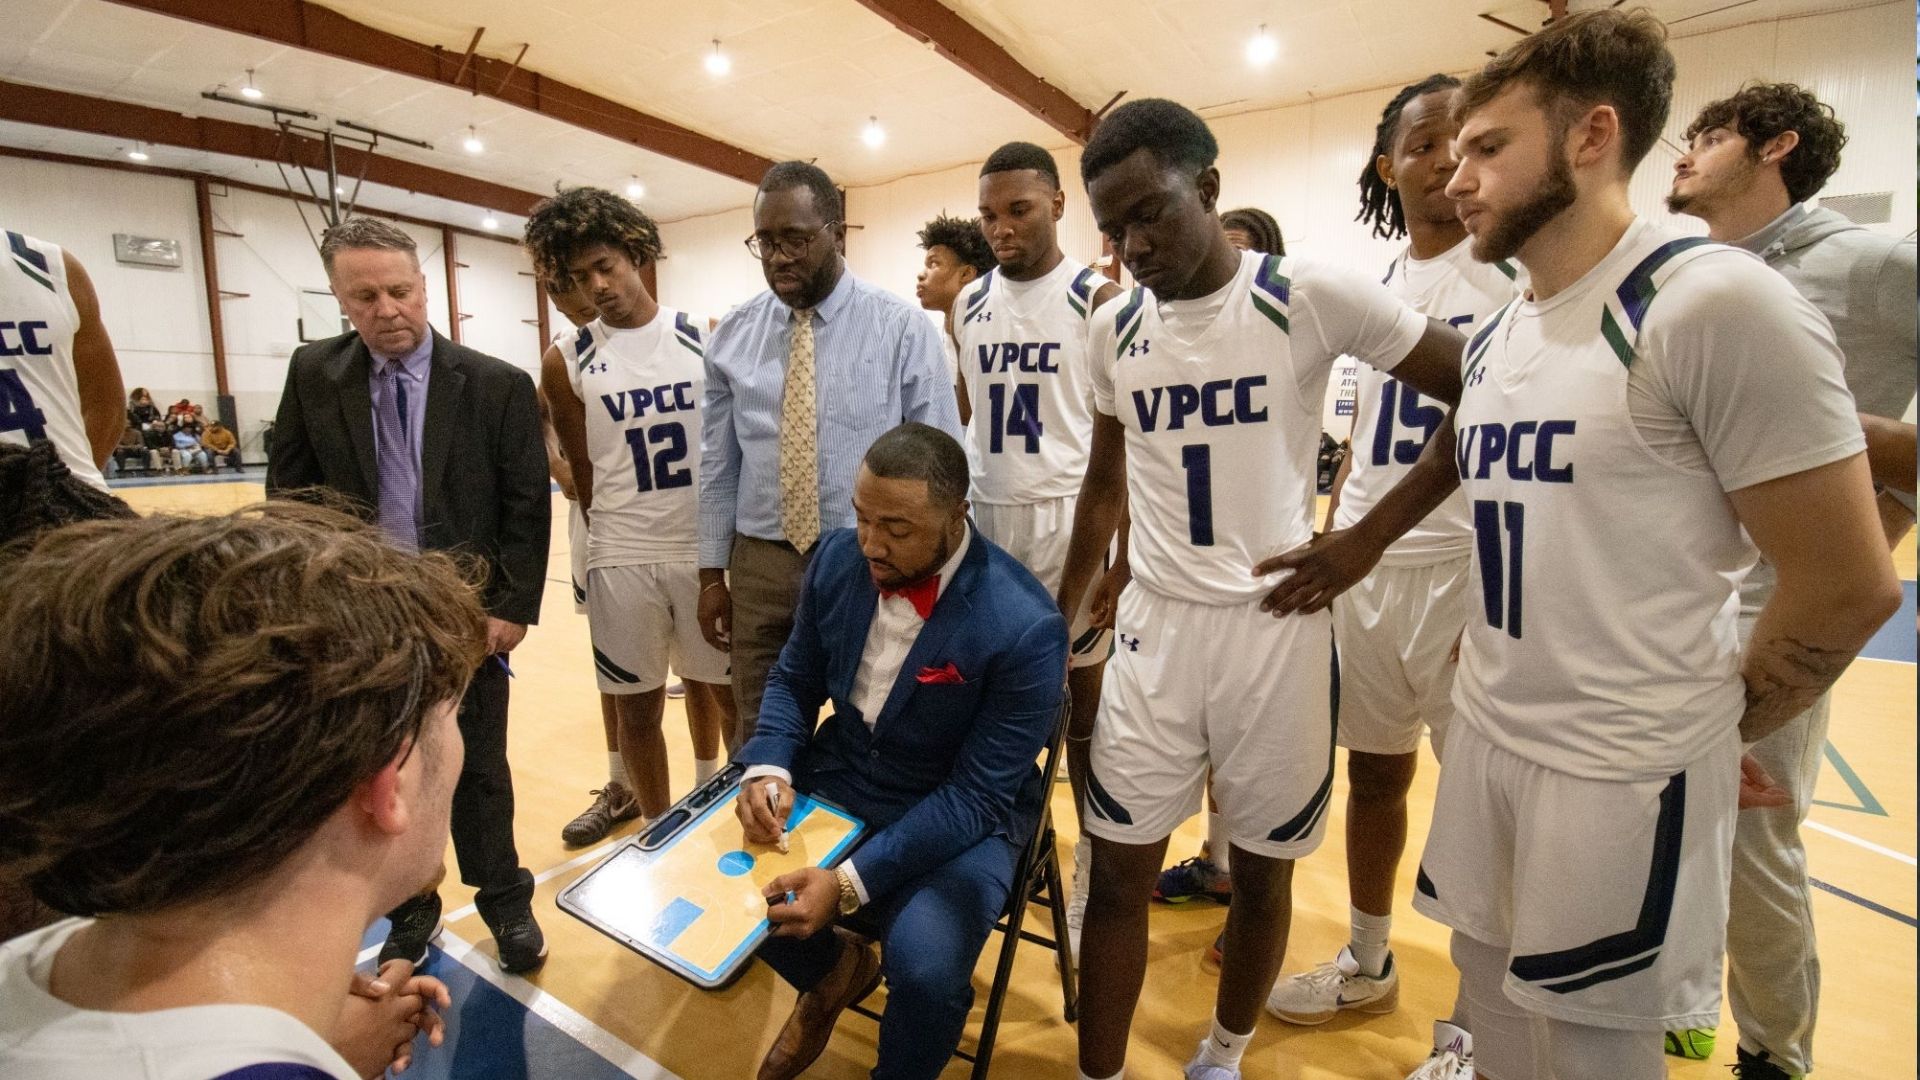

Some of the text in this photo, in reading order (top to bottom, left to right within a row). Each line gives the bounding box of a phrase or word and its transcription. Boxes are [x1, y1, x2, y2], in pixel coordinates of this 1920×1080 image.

[978, 342, 1061, 374] VPCC
[600, 381, 696, 422] VPCC
[989, 383, 1043, 454] 14
[1132, 375, 1268, 433] VPCC
[1372, 379, 1446, 466] 15
[625, 421, 692, 493] 12
[1457, 420, 1576, 484] VPCC
[1182, 443, 1214, 546] 1
[1474, 500, 1524, 640] 11
